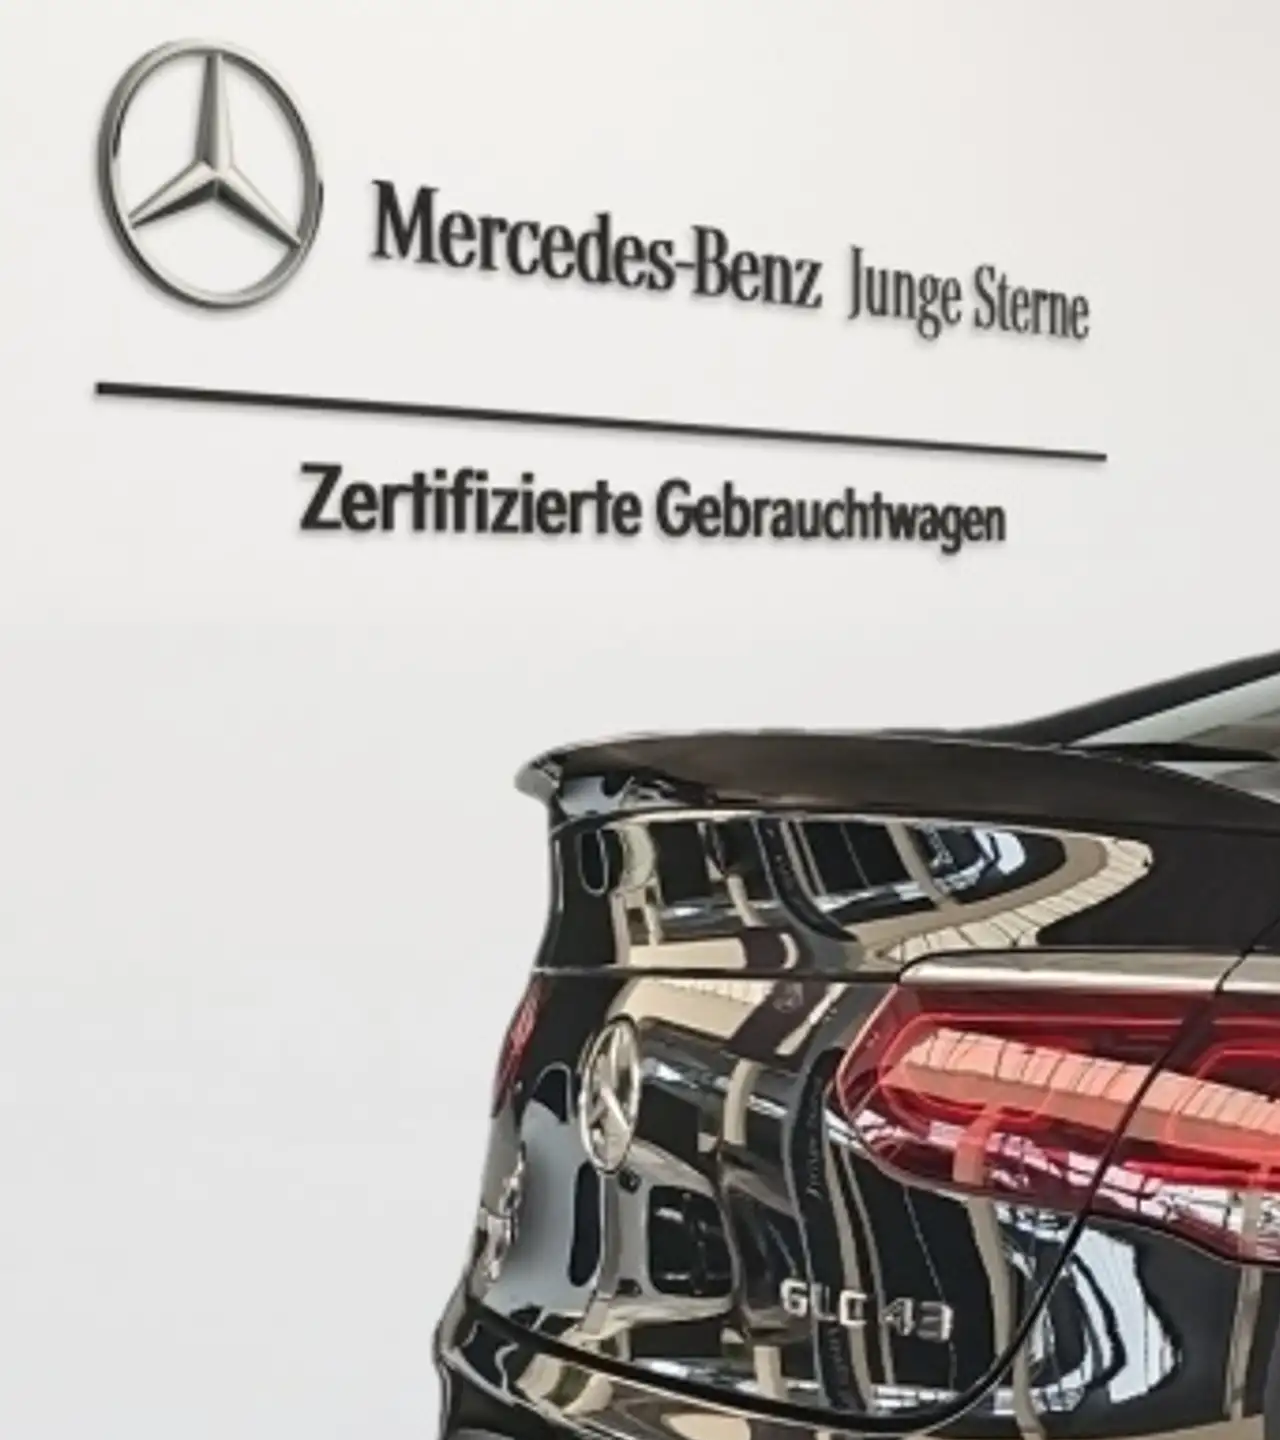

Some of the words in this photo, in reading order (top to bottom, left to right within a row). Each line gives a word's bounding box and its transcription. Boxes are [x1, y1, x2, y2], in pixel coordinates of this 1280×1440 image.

[371, 179, 823, 309] Mercedes-Benz
[847, 245, 962, 341] Junge
[973, 264, 1090, 341] Sterne
[299, 462, 643, 537] Zertifizierte
[655, 477, 1008, 555] Gebrauchtwagen
[880, 1297, 954, 1342] 43
